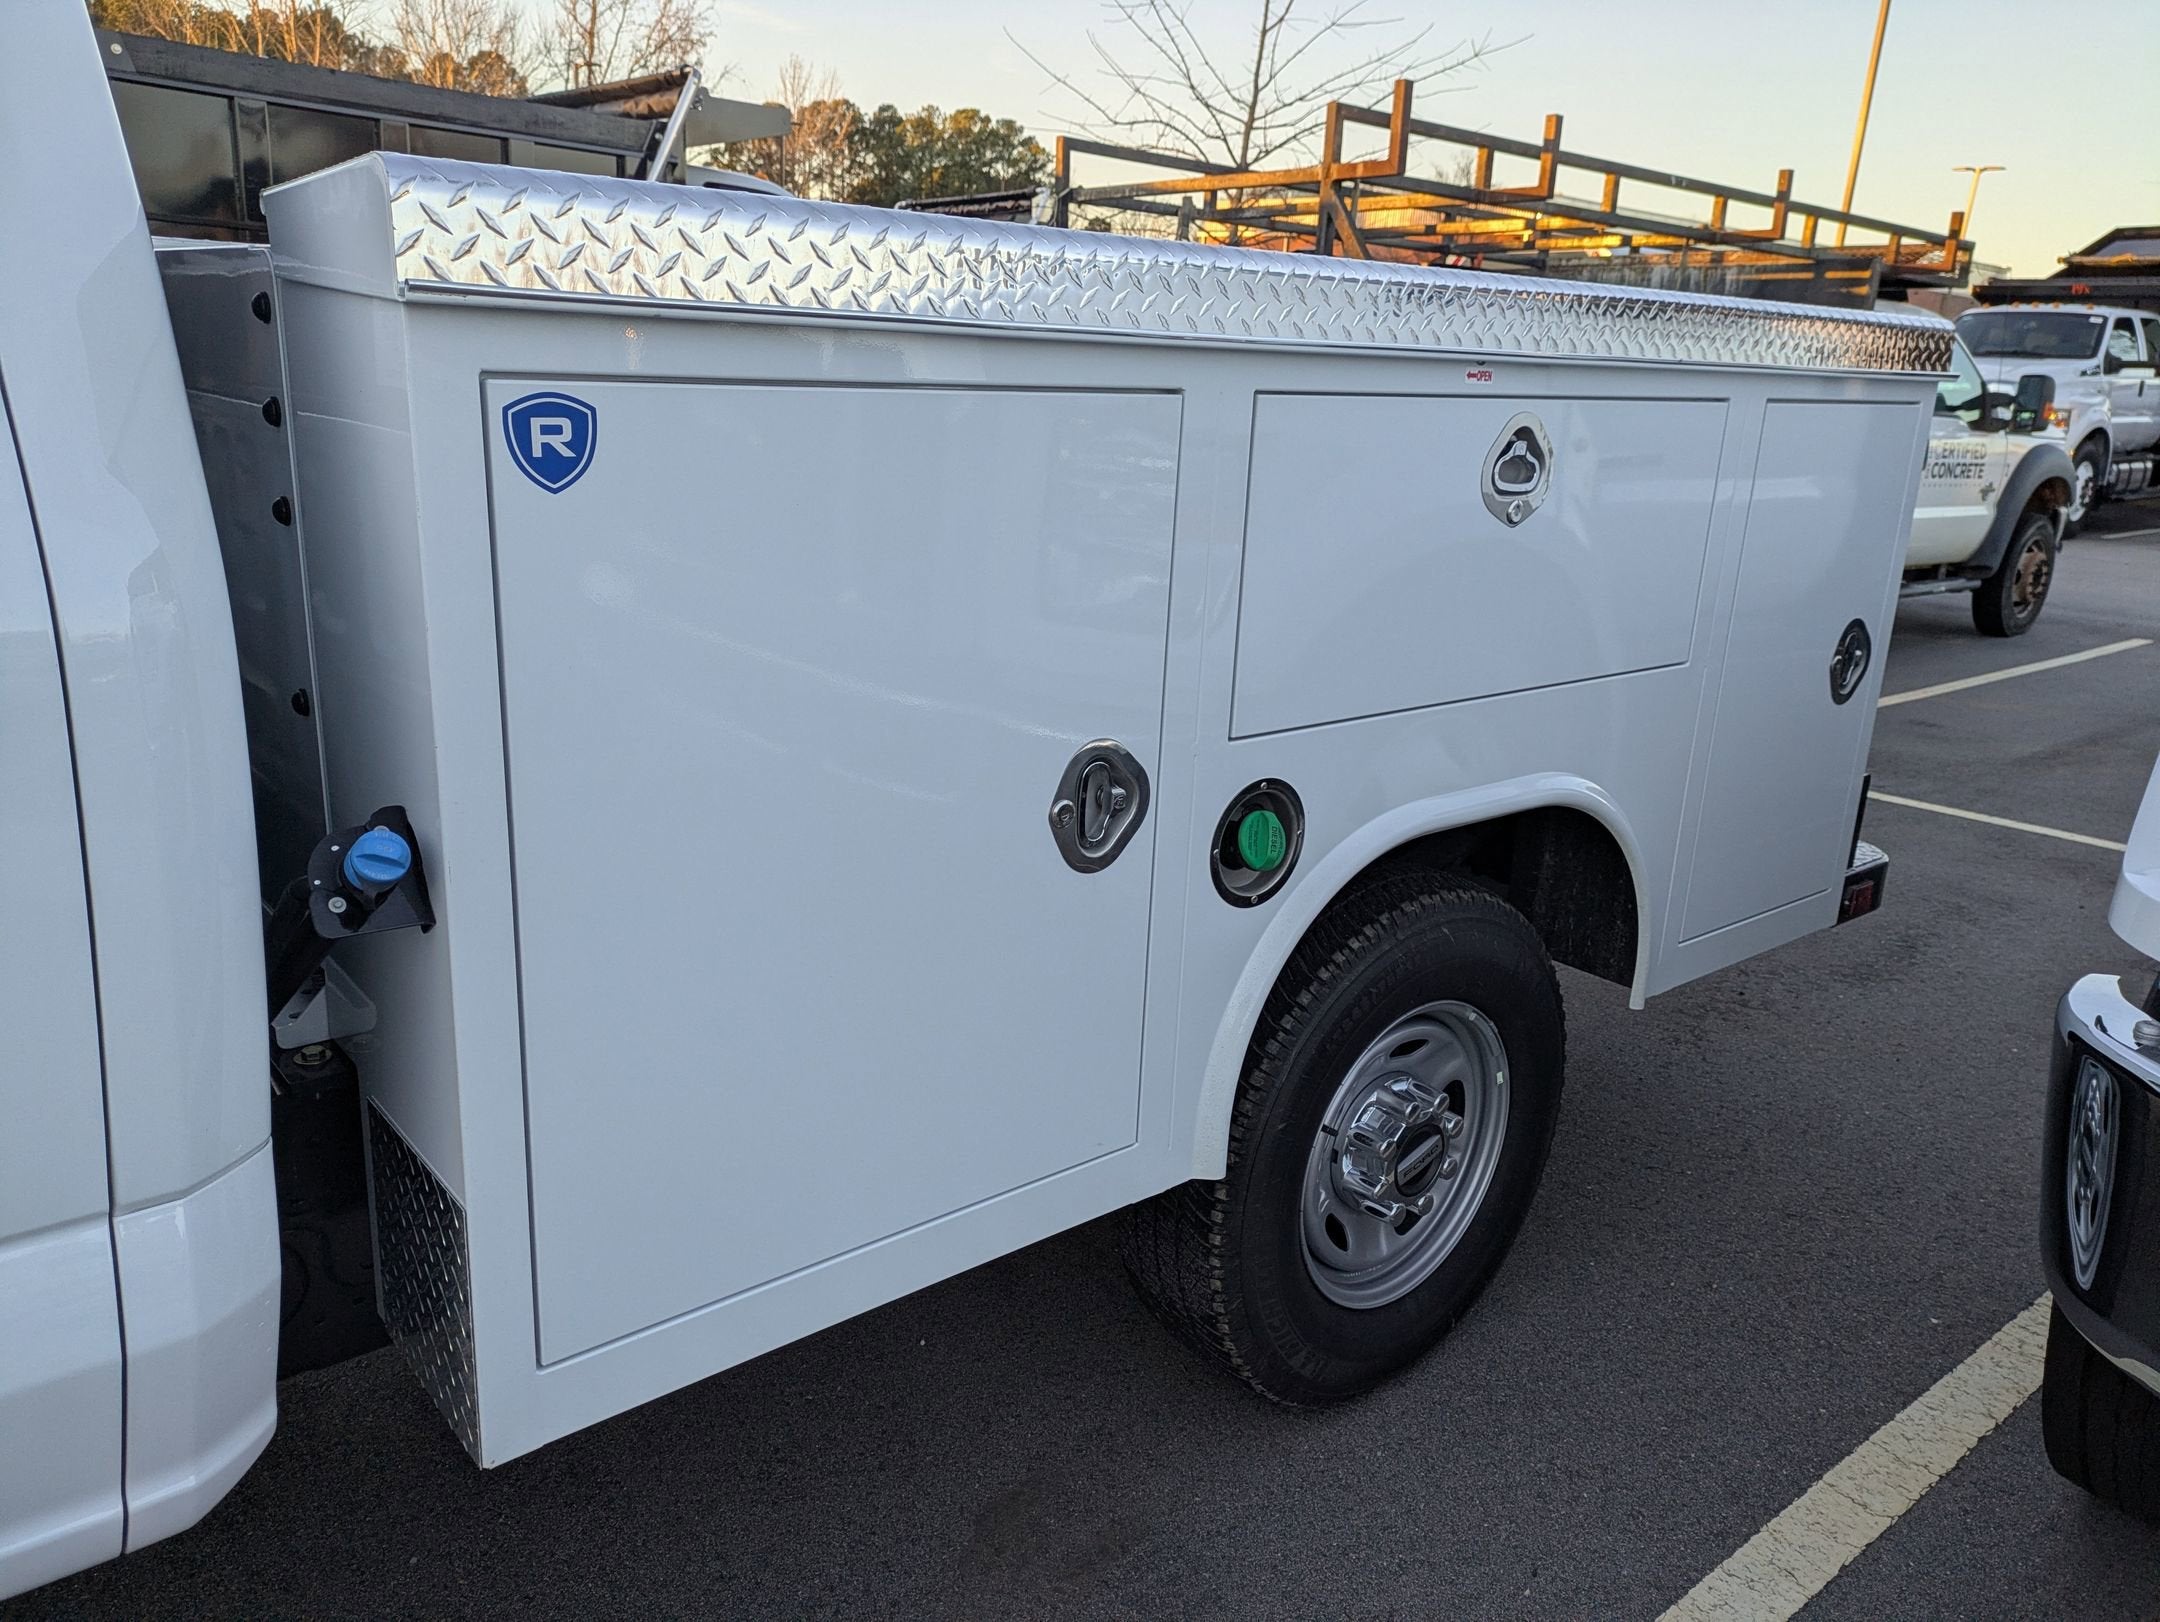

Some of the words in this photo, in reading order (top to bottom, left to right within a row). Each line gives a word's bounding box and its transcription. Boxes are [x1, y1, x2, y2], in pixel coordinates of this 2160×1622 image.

[1477, 370, 1493, 382] OPEN
[530, 417, 577, 458] R
[1930, 462, 1985, 479] CONCRETE
[1403, 1144, 1439, 1178] FORD
